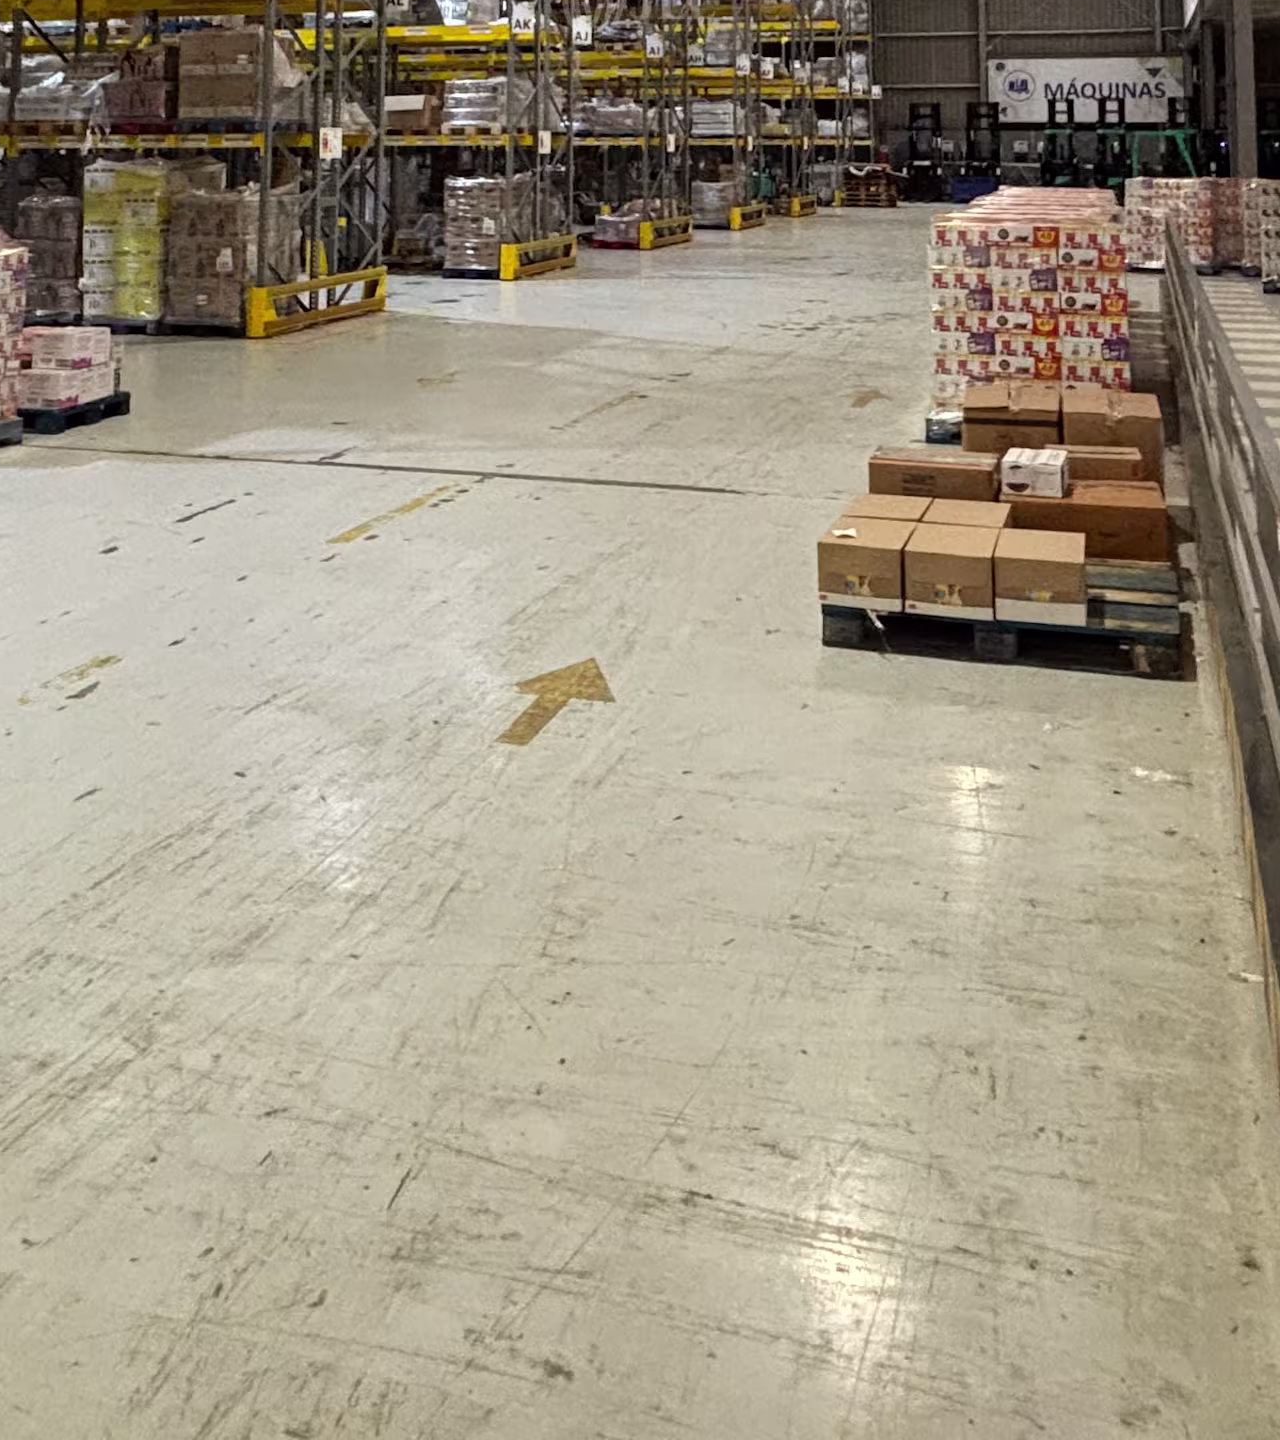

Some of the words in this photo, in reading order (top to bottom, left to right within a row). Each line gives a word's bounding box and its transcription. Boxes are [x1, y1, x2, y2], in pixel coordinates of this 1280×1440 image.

[514, 18, 532, 30] AK
[575, 31, 589, 41] AJ
[1044, 78, 1166, 101] MÁQUINAS
